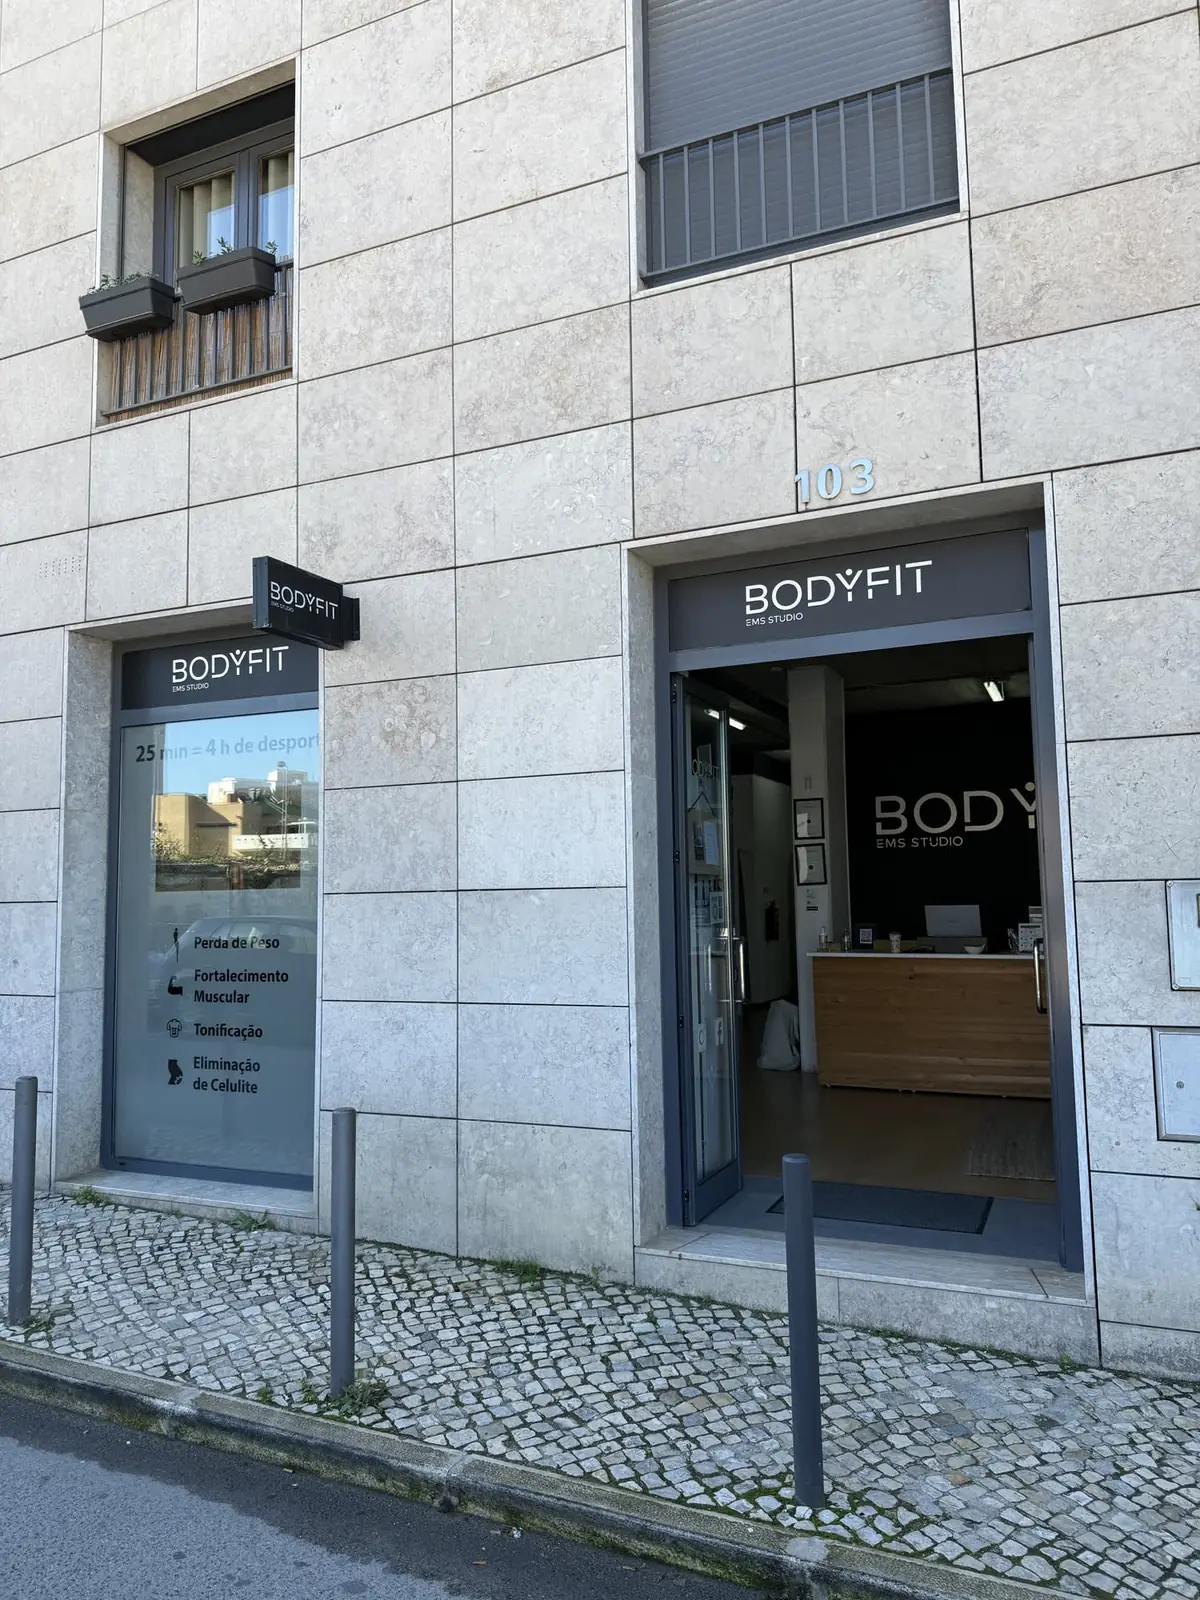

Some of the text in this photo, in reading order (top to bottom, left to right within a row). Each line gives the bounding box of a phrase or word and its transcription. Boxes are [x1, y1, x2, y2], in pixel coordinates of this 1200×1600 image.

[794, 457, 875, 504] 103
[745, 560, 933, 615] BODYFIT
[270, 581, 339, 620] BODYFIT
[745, 612, 804, 627] EMS STUDIO
[172, 645, 289, 683] BODYFIT
[172, 682, 209, 693] EMS STUDIO
[135, 744, 156, 763] 25
[159, 744, 188, 760] min
[205, 738, 217, 756] 4
[220, 739, 230, 755] h
[234, 737, 254, 754] de
[875, 781, 1037, 836] BODY
[876, 836, 964, 849] EMS STUDIO
[194, 936, 280, 950] Perda de Peso
[194, 968, 289, 983] Fortalecimento
[194, 990, 250, 1004] Muscular
[194, 1023, 263, 1041] Tonificação
[193, 1056, 260, 1075] Eliminação
[193, 1077, 258, 1094] de Celulite
